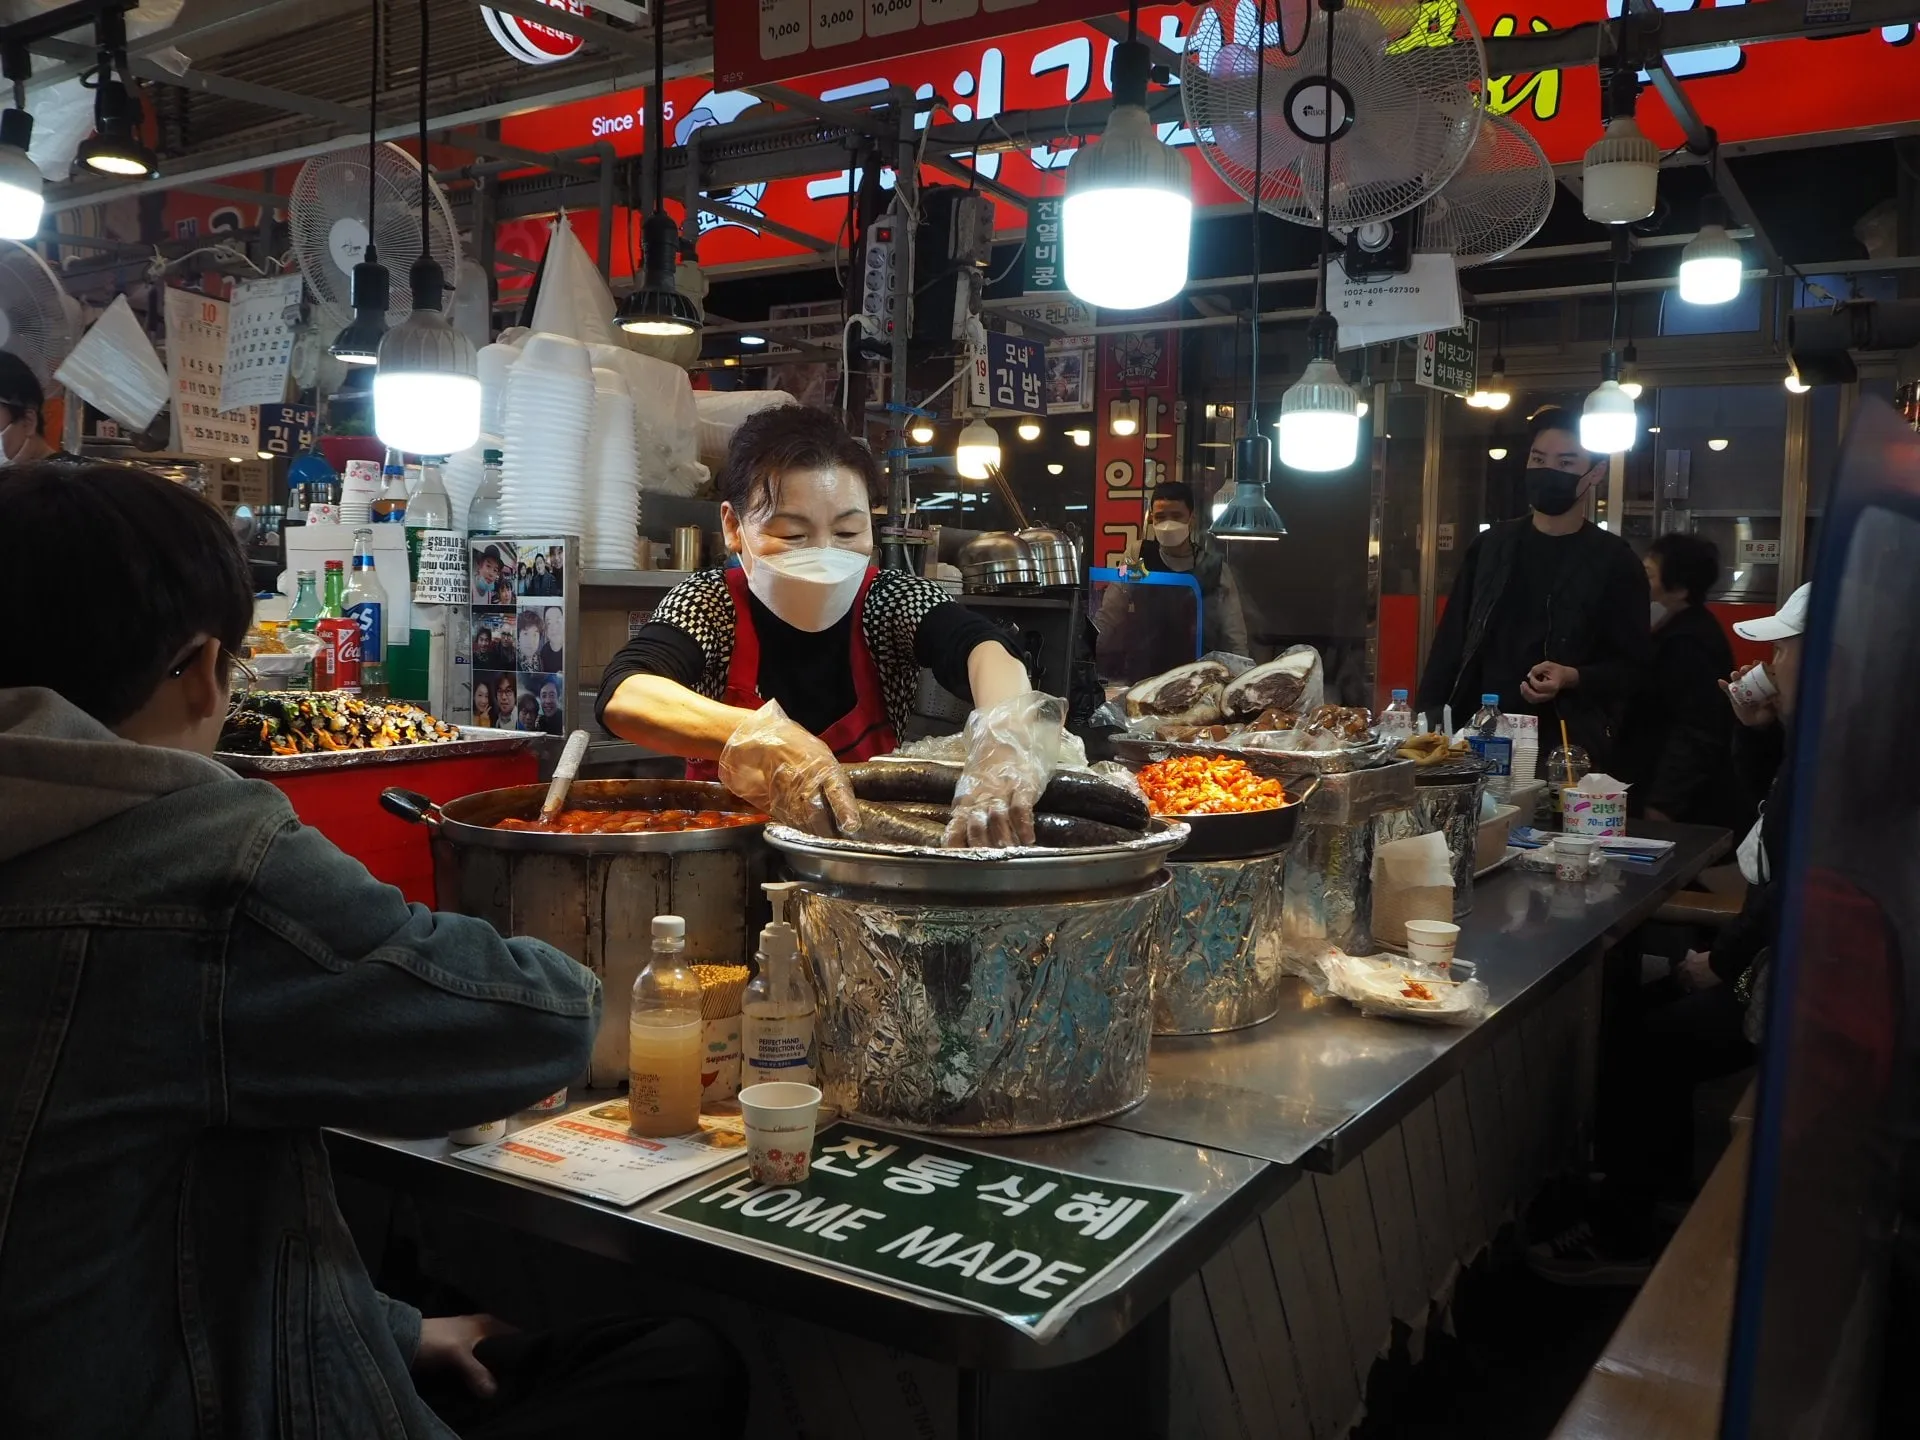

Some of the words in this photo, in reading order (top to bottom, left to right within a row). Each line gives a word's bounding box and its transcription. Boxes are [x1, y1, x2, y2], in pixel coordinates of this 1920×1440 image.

[820, 9, 854, 28] 3,000
[591, 114, 634, 137] Since
[637, 100, 674, 127] 15
[202, 303, 217, 323] 10
[1005, 343, 1028, 368] 모녀
[1438, 341, 1474, 367] 머릿고기
[975, 359, 987, 378] 19
[1437, 362, 1473, 391] 허파볶음
[996, 368, 1041, 409] 김밥
[434, 536, 459, 548] OTHERS
[439, 562, 461, 571] truth
[444, 553, 458, 561] SAY
[434, 577, 452, 587] YOUR
[438, 593, 467, 603] RULES
[781, 1037, 800, 1045] HAND
[809, 1135, 1149, 1241] 전통식혜
[699, 1178, 887, 1243] HOME
[876, 1225, 1087, 1300] MADE
